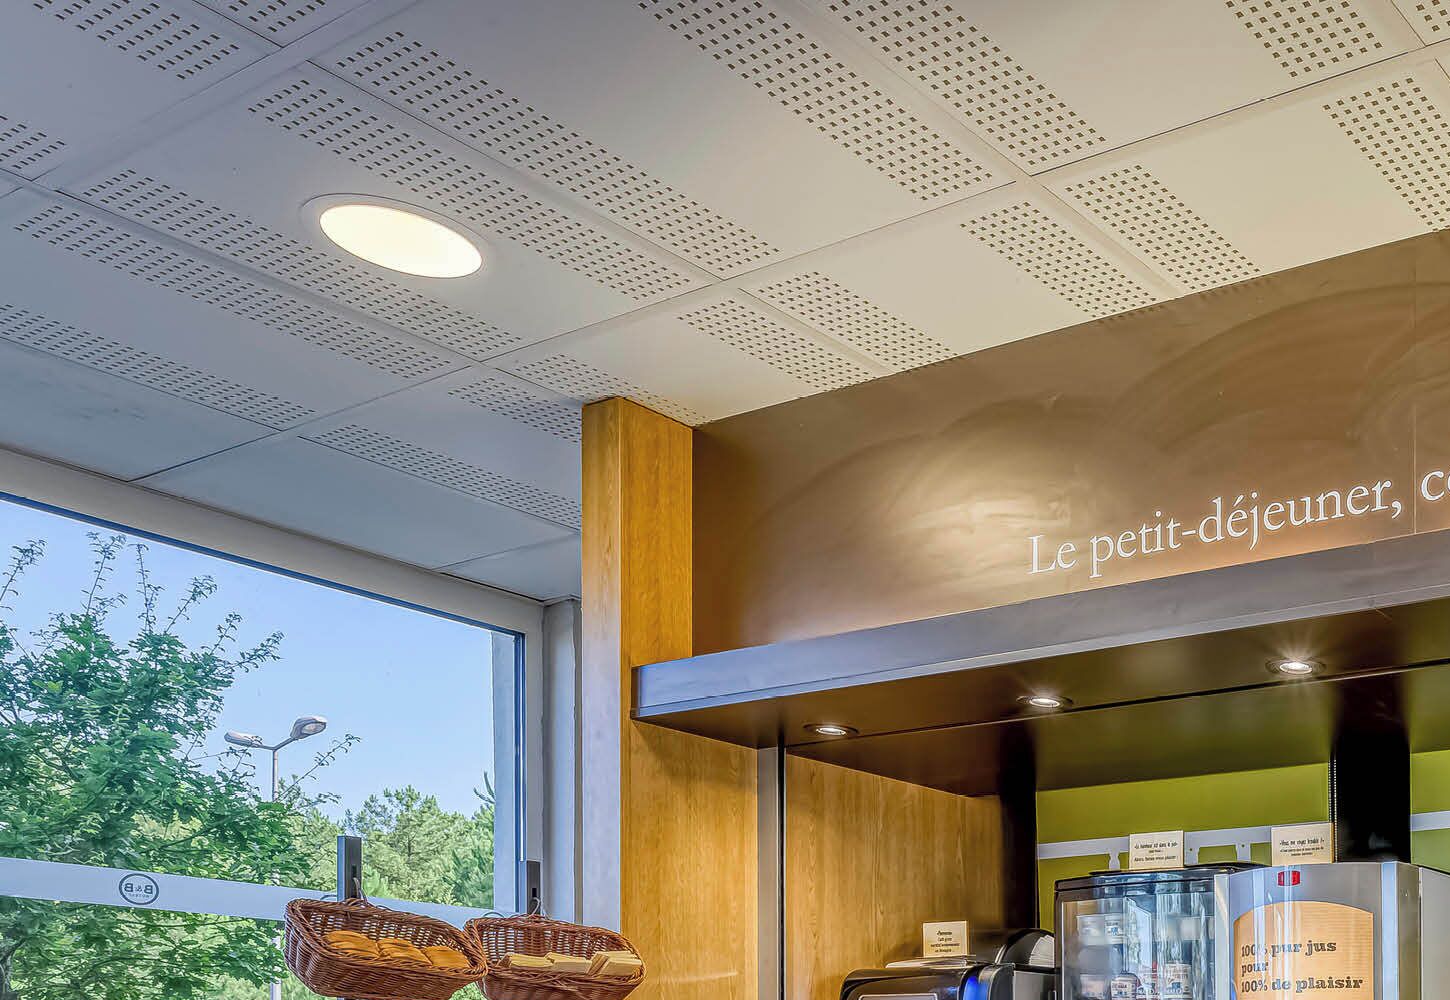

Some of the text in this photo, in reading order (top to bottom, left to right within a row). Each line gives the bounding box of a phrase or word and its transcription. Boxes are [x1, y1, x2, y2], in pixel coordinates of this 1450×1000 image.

[1027, 534, 1077, 576] Le
[1088, 476, 1404, 580] petit-déjeuner,
[1271, 944, 1302, 957] pur
[1305, 940, 1337, 956] jus
[1241, 961, 1269, 977] pour
[1241, 976, 1363, 993] 100% de plaisir
